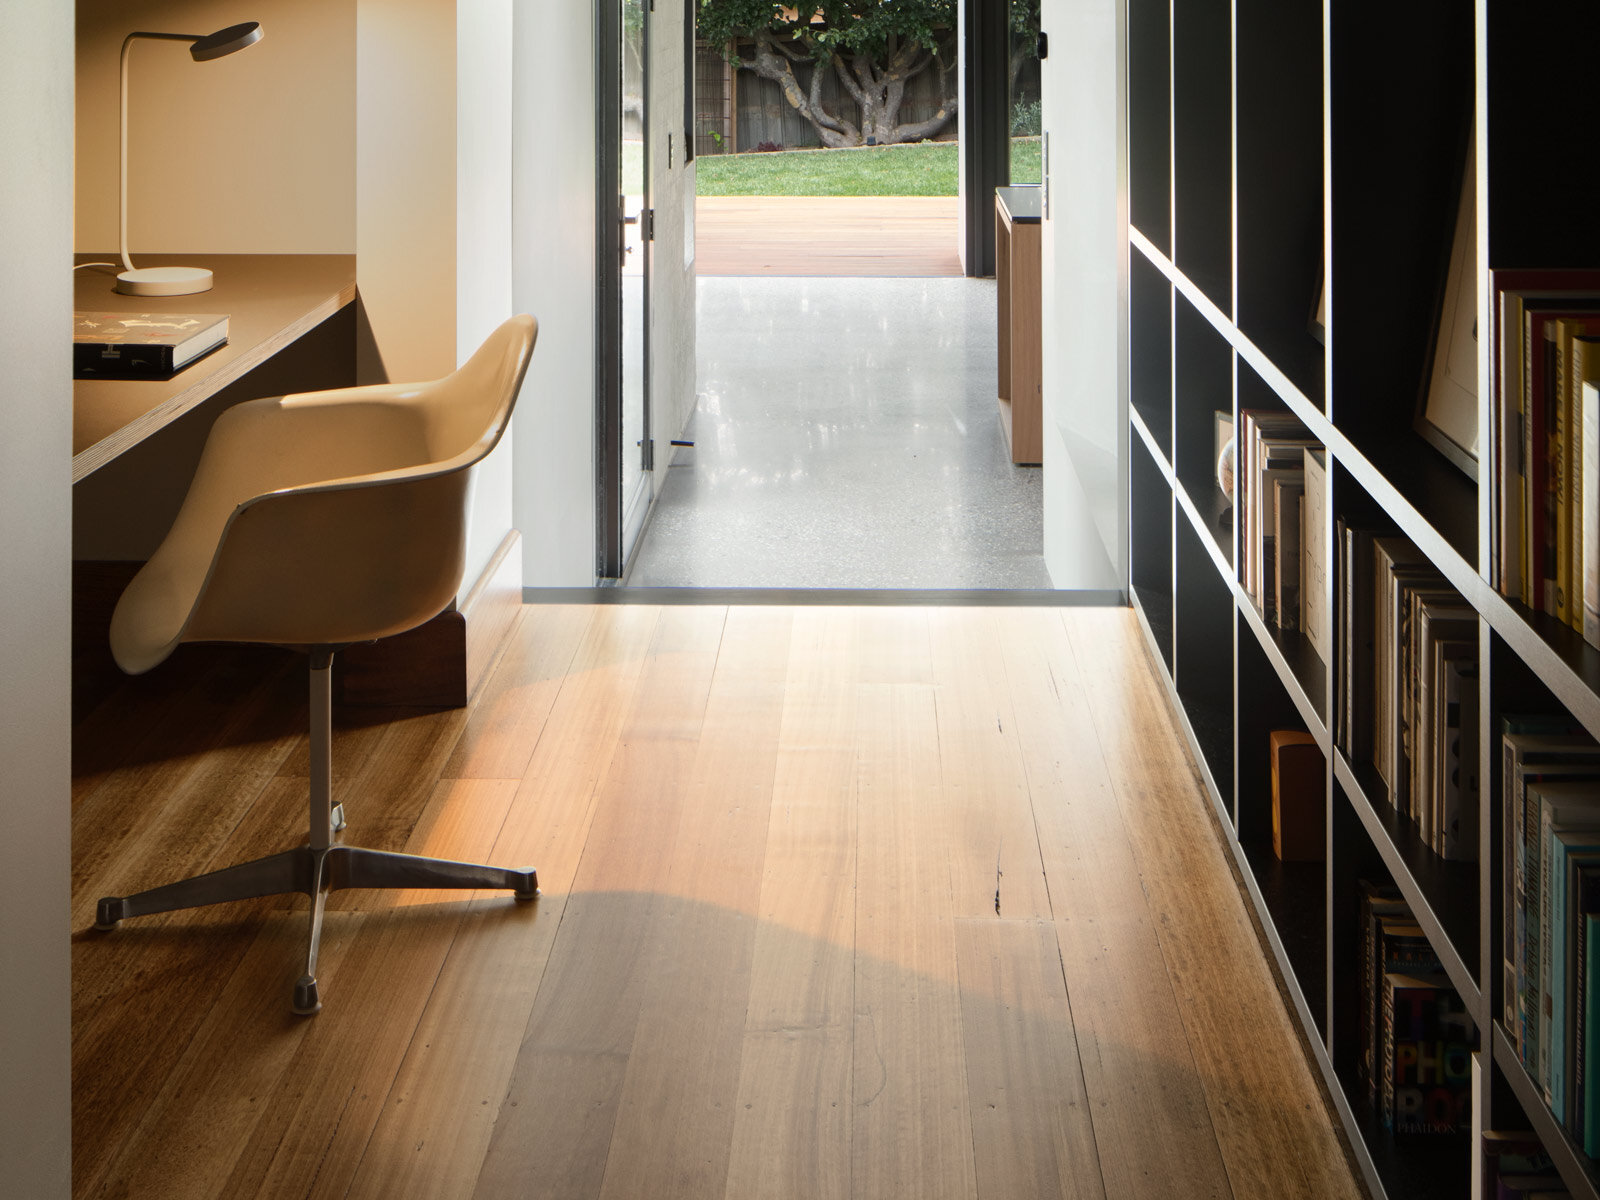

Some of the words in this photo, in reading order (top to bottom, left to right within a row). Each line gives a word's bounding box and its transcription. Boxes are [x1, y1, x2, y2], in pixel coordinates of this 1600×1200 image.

[1557, 416, 1564, 435] IT
[1556, 442, 1564, 505] NOW!
[1528, 799, 1538, 849] BRAND
[1528, 854, 1539, 920] THINKING
[1528, 931, 1538, 981] Debbie
[1527, 981, 1539, 1041] Millman
